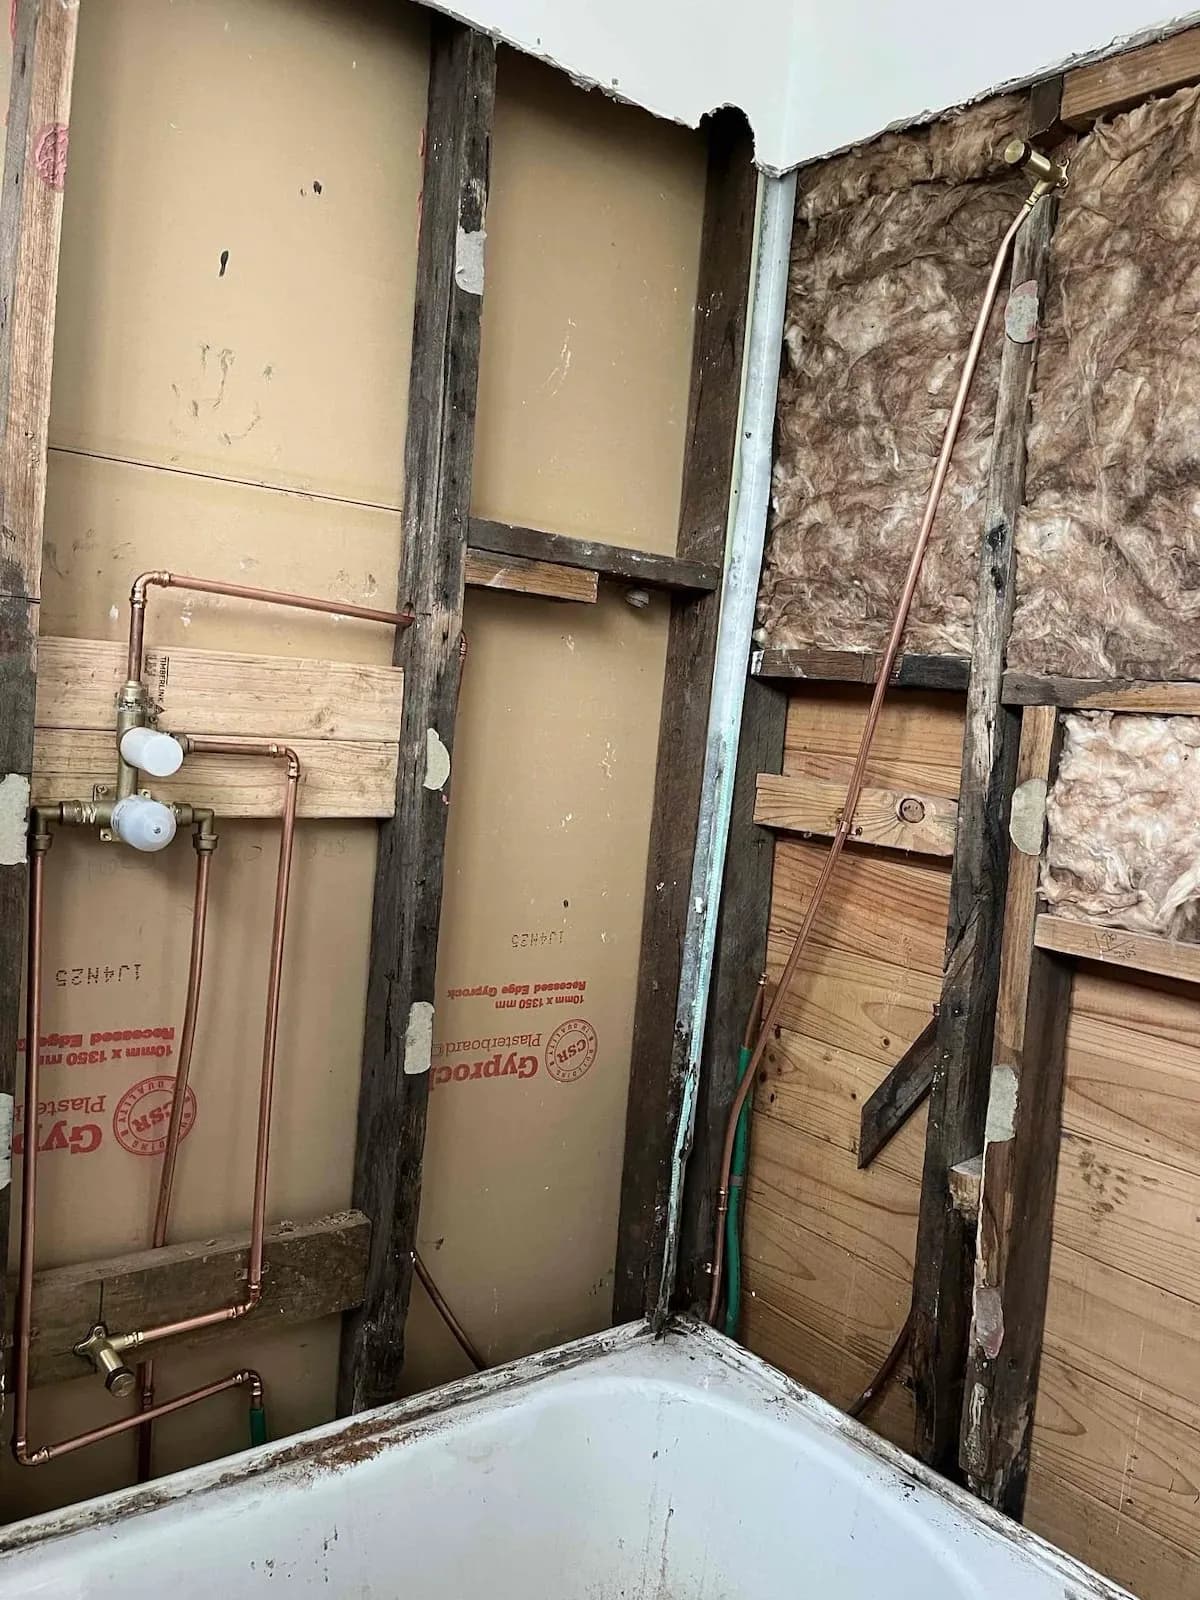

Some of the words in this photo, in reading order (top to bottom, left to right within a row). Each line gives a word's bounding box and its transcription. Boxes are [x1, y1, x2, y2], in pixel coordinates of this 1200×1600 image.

[158, 656, 166, 702] TIMBERLINK
[447, 985, 498, 999] Gyprock
[502, 983, 530, 996] Edge
[533, 980, 587, 995] Recessed
[495, 1000, 516, 1010] mm
[518, 998, 545, 1009] 1350
[546, 998, 554, 1006] x
[555, 994, 585, 1005] 10mm
[90, 1027, 175, 1046] Recessed
[125, 1045, 173, 1058] 10mm
[446, 1033, 543, 1057] Plasterboard
[556, 1039, 587, 1063] CSR
[66, 1051, 107, 1066] 1350
[111, 1049, 123, 1060] x
